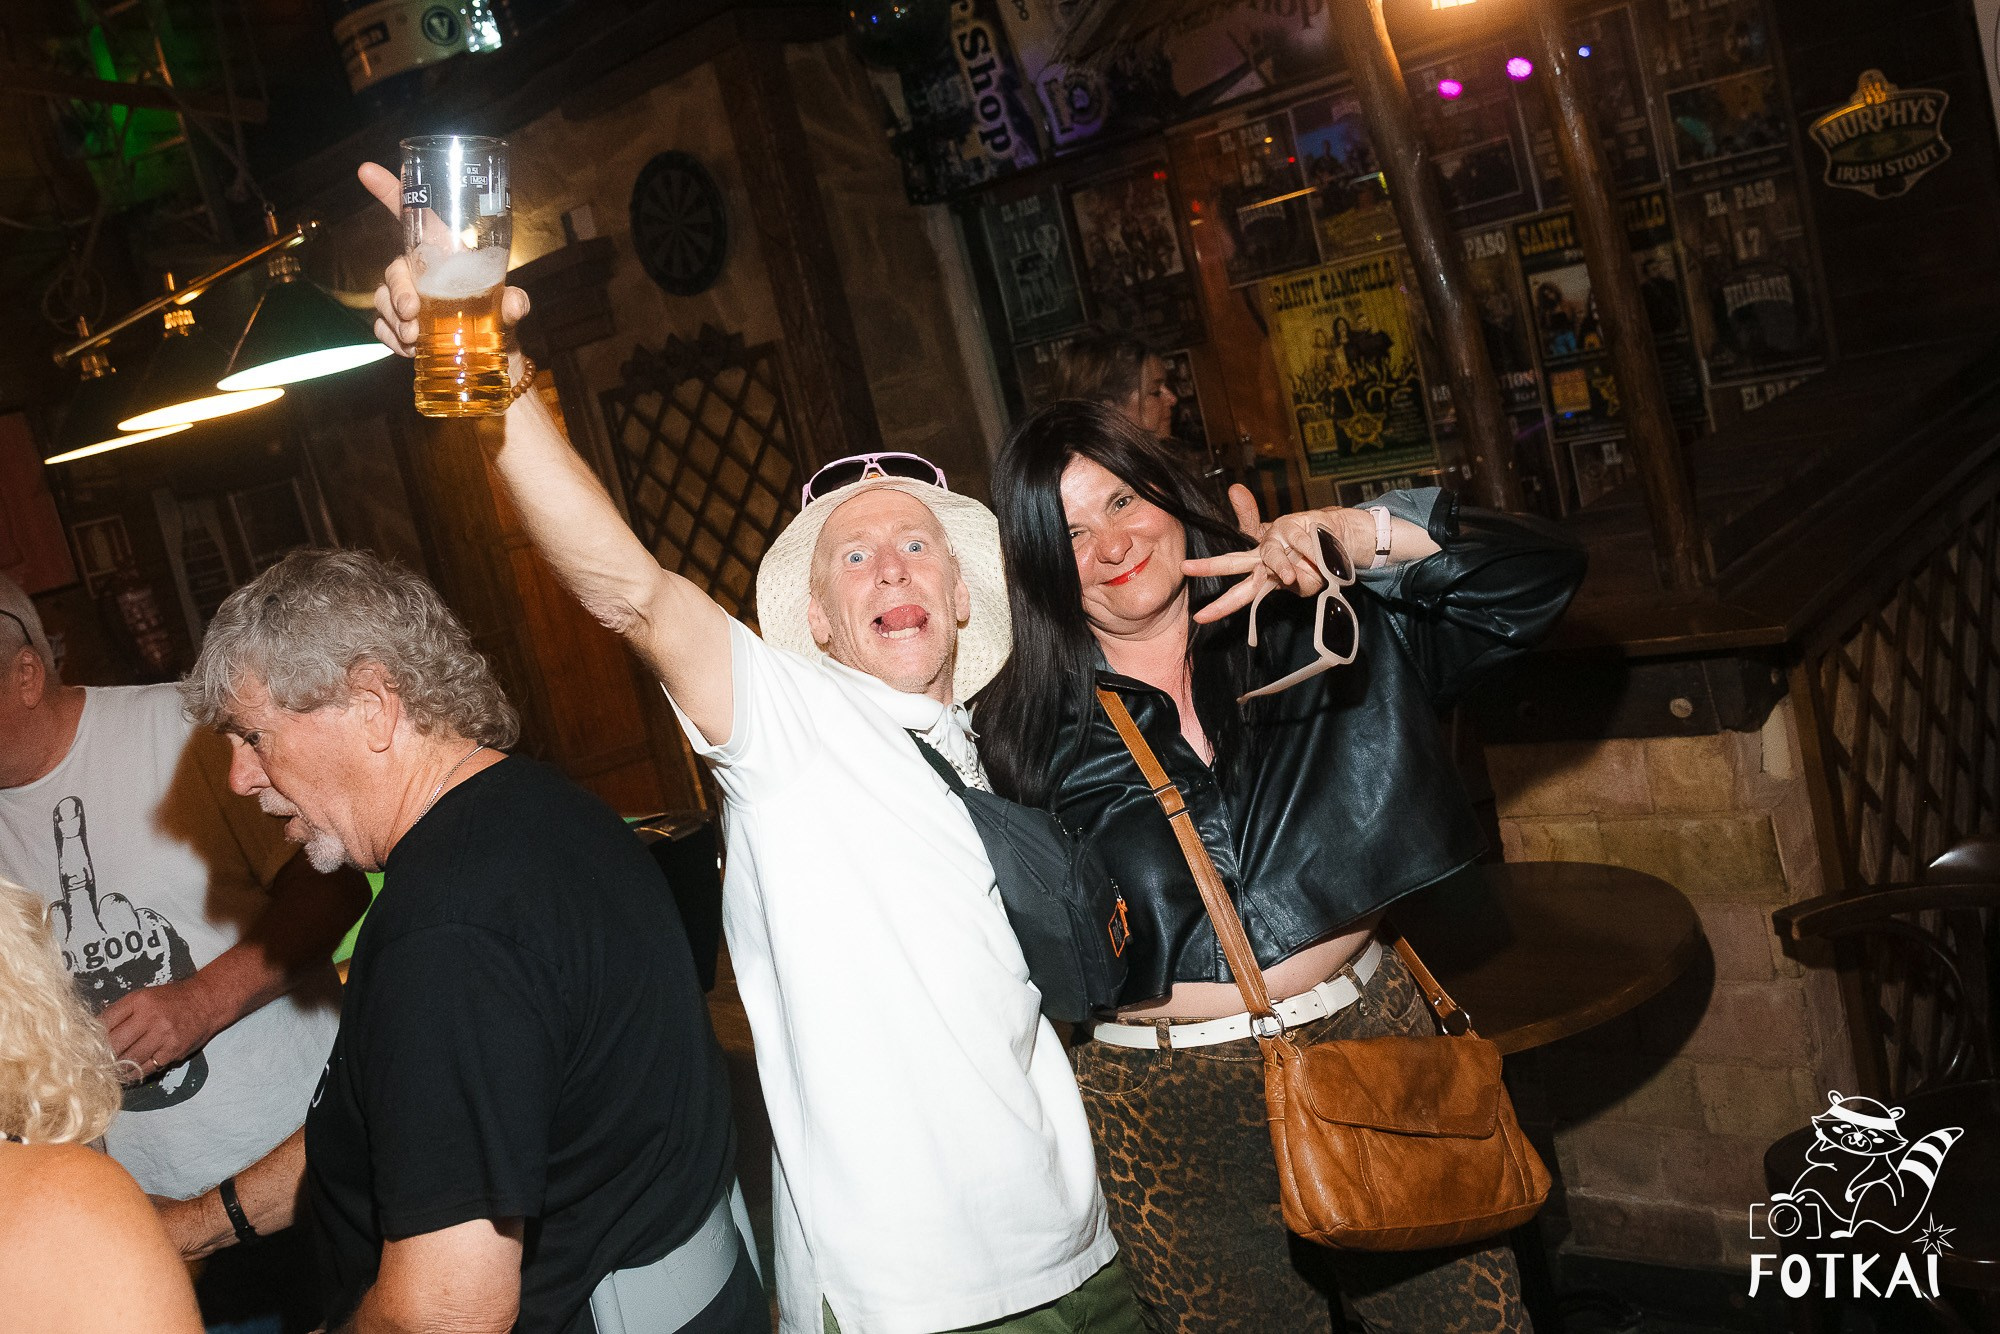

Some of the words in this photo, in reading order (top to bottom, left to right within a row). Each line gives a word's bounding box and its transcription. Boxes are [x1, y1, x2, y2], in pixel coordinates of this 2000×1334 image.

[957, 26, 1013, 153] Shop
[1835, 164, 1884, 183] IRISH
[1884, 143, 1940, 178] STOUT
[1704, 191, 1728, 218] EL
[1733, 178, 1777, 211] PASO
[1463, 230, 1508, 262] PASO
[1518, 216, 1573, 256] SANTI
[1273, 278, 1319, 311] SANTI
[1320, 260, 1395, 300] CAMPILLO
[82, 928, 162, 970] good
